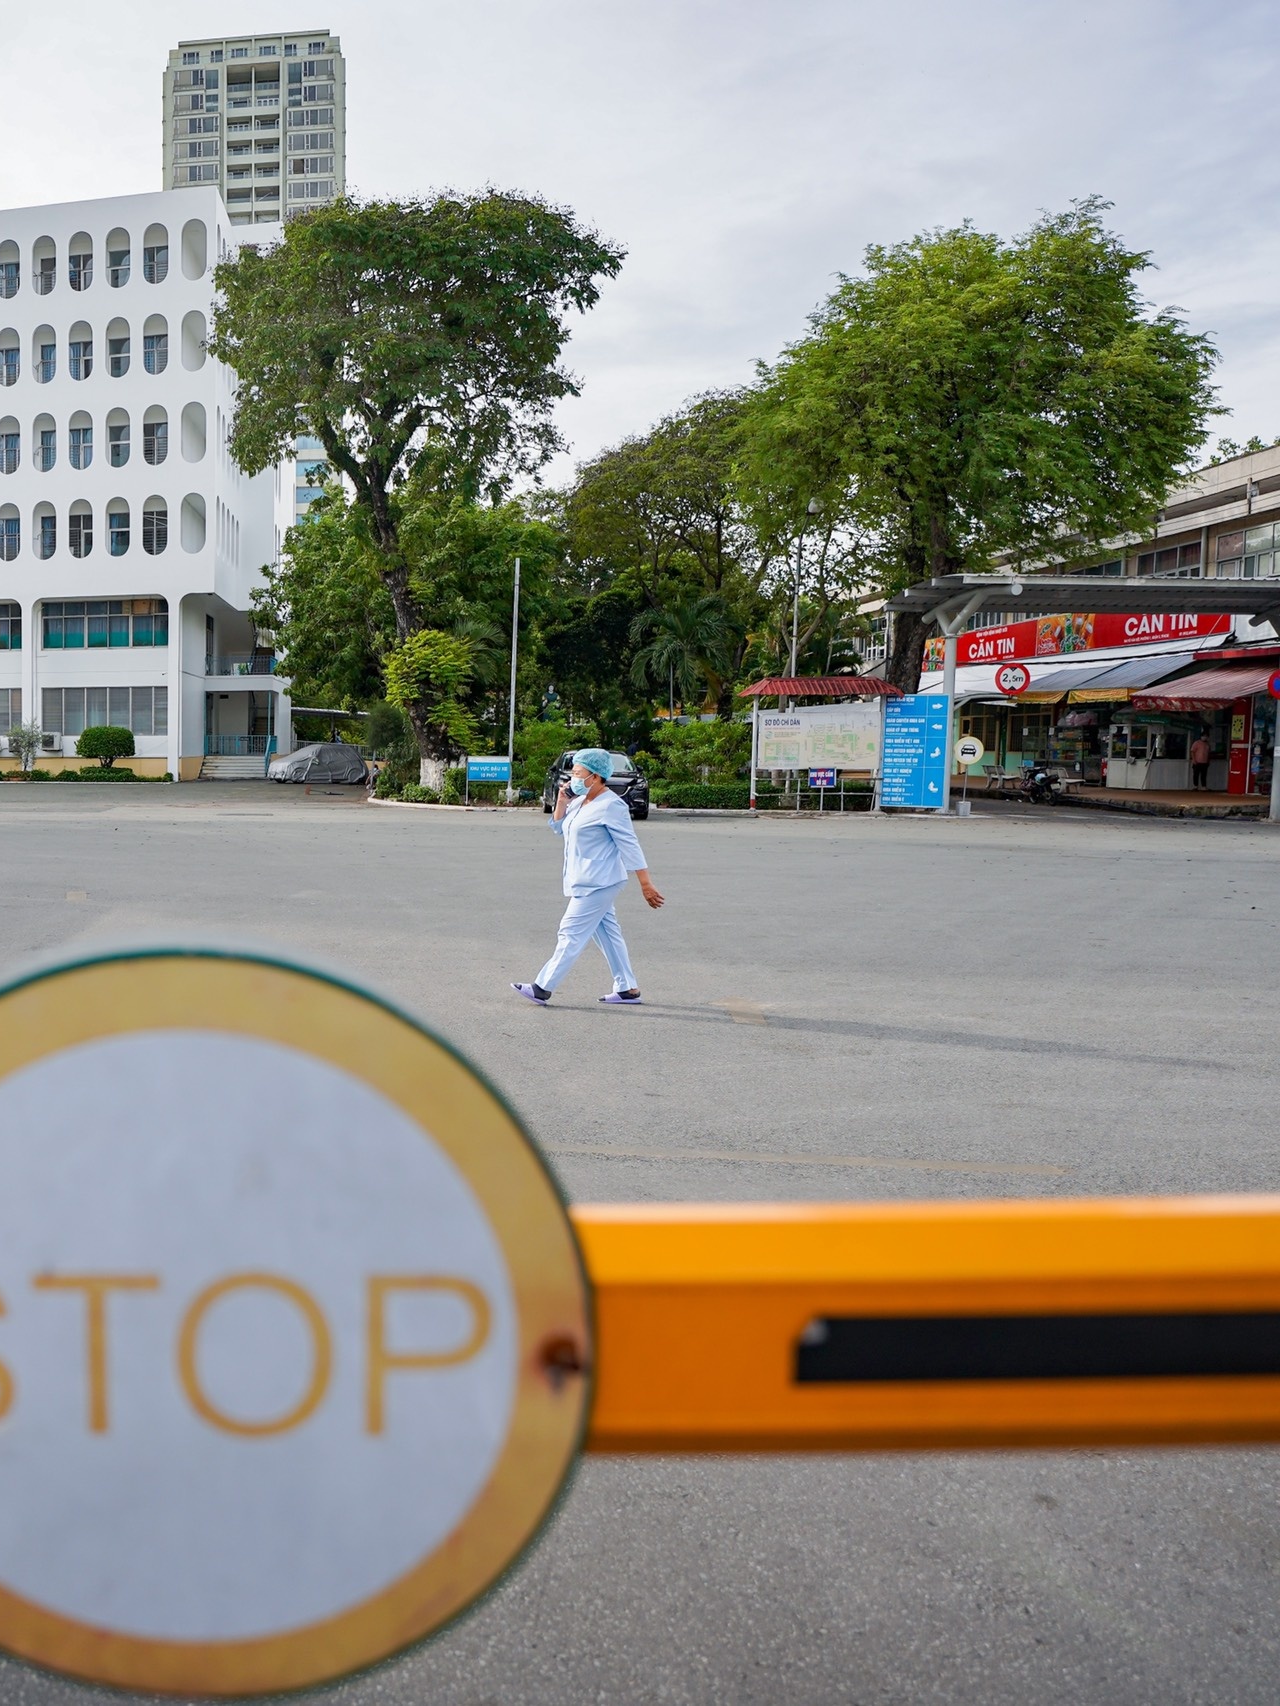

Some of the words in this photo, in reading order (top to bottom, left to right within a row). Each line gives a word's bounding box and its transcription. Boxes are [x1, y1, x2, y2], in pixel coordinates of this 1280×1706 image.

[1125, 614, 1164, 636] CĂN
[1169, 614, 1198, 630] TIN
[969, 638, 994, 659] CĂN
[997, 637, 1015, 654] TIN
[1002, 673, 1024, 683] 2,5m
